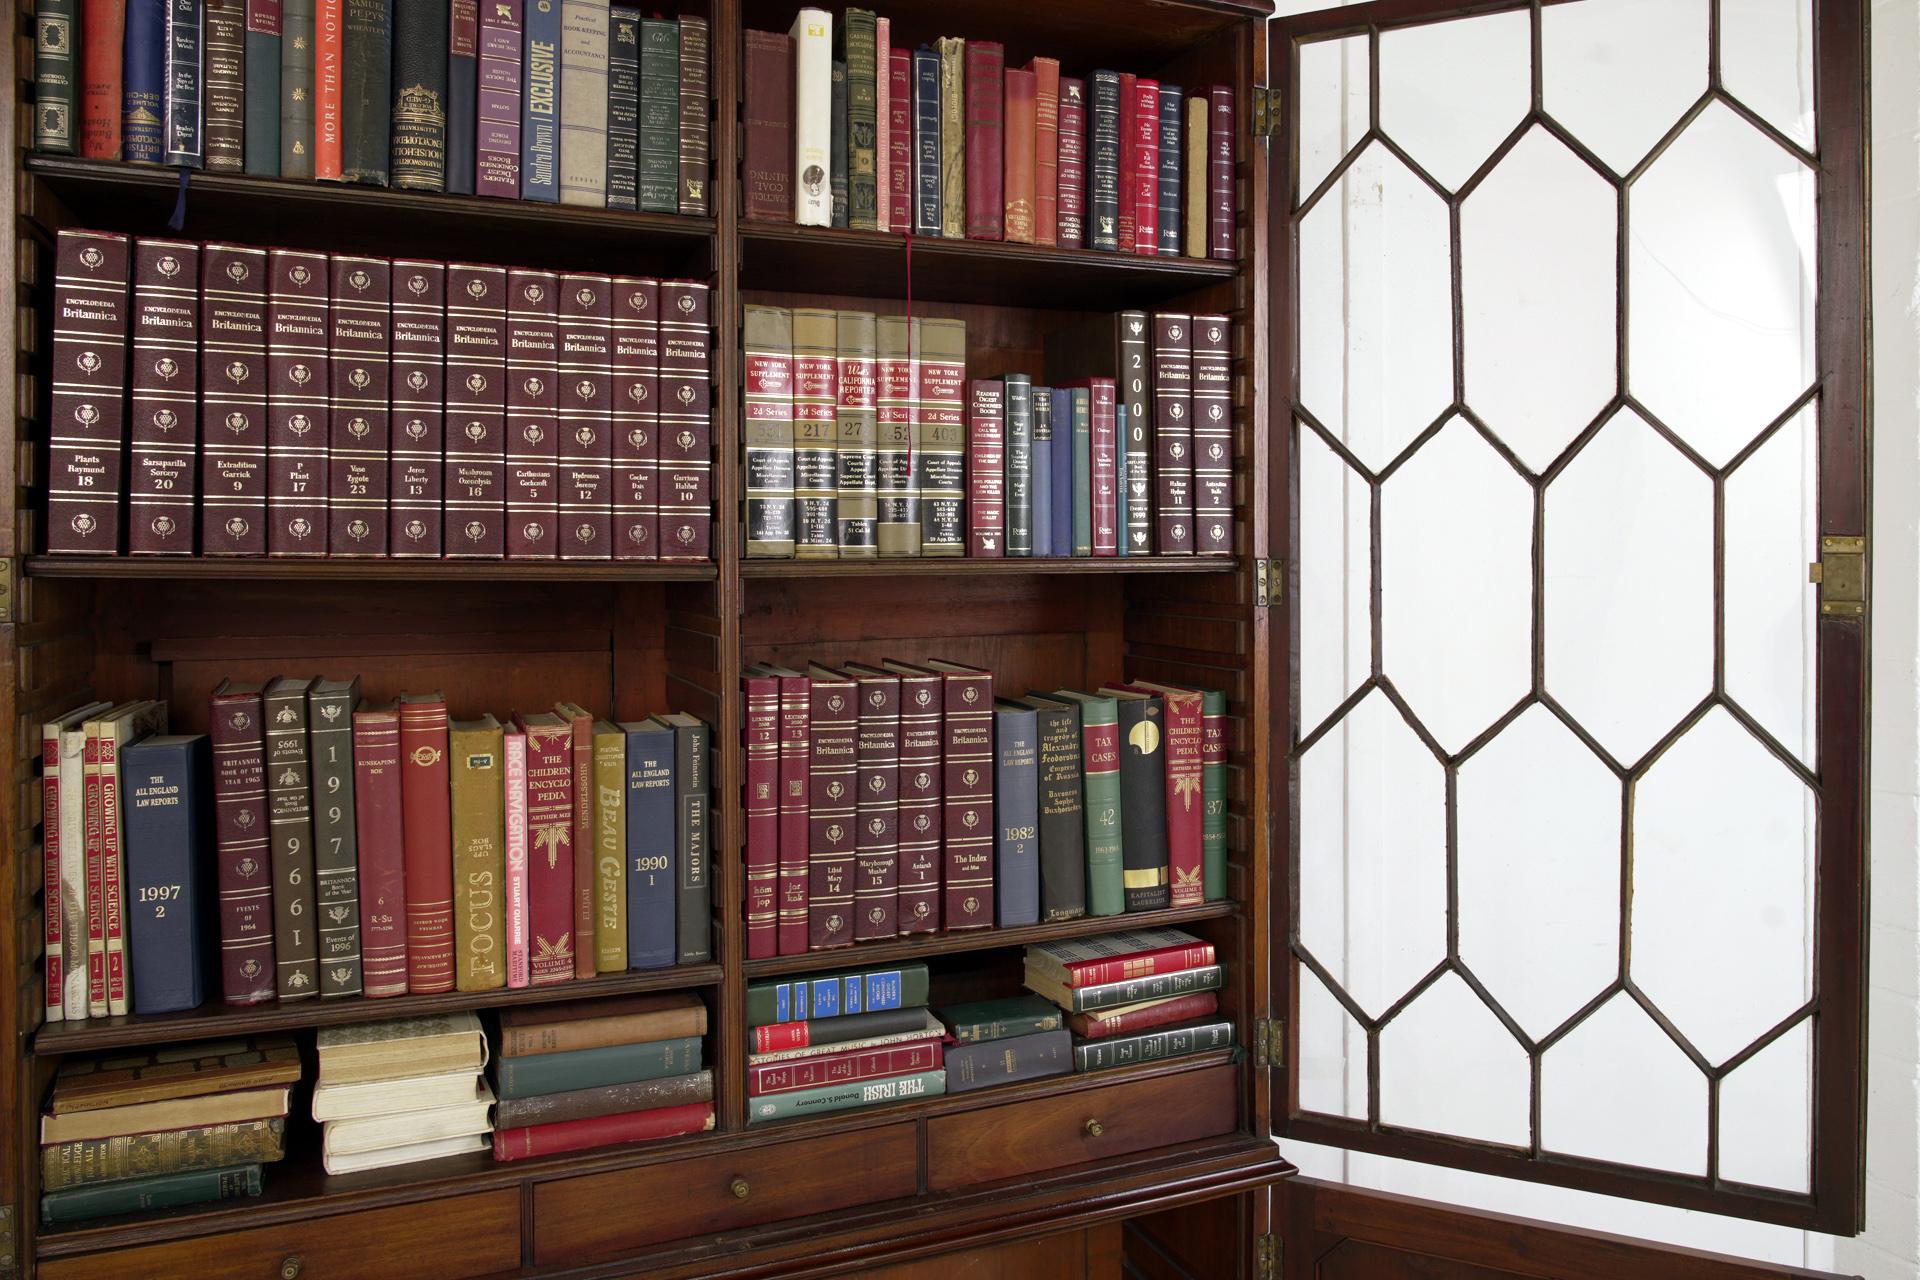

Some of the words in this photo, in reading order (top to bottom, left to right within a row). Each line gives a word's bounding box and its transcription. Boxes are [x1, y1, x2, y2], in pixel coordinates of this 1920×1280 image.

[563, 49, 606, 60] ACCOUNTANCY
[325, 54, 336, 93] THAN
[529, 40, 555, 114] EXCLUSIVE
[325, 104, 336, 143] MORE
[488, 156, 511, 165] BOOKS
[480, 161, 519, 173] CONDENSED
[530, 153, 553, 185] Sandra
[488, 168, 511, 178] DIGEST
[483, 175, 515, 186] READER'S
[755, 181, 784, 192] COAL
[63, 307, 118, 321] Britannica
[141, 315, 193, 328] Britannica
[212, 319, 262, 332] Britannica
[275, 323, 323, 336] Britannica
[335, 327, 383, 340] Britannica
[395, 331, 440, 343] Britannica
[454, 334, 499, 346] Britannica
[511, 338, 555, 350] Britannica
[617, 345, 658, 356] Britannica
[754, 360, 769, 368] NEW
[771, 361, 787, 369] YORK
[816, 363, 832, 371] YORK
[750, 370, 790, 379] SUPPLEMENT
[795, 373, 835, 381] SUPPLEMENT
[944, 369, 959, 377] YORK
[1160, 371, 1191, 380] Britannica
[838, 377, 876, 385] CALIFORNIA
[839, 386, 876, 394] REPORTER
[976, 391, 999, 399] READER'S
[973, 402, 1002, 410] CONDENSED
[753, 408, 762, 416] 2d
[764, 408, 788, 416] Series
[799, 408, 808, 416] 2d
[810, 408, 833, 416] Series
[927, 413, 937, 421] 2d
[939, 413, 960, 421] Series
[844, 423, 862, 436] 27
[75, 455, 100, 463] Plants
[143, 458, 187, 468] Sarsaparilla
[68, 464, 105, 474] Raymund
[217, 460, 257, 470] Extradition
[350, 464, 366, 473] Vase
[150, 468, 179, 478] Sorcery
[222, 470, 252, 479] Garrick
[407, 466, 426, 475] Jerez
[78, 476, 94, 486] 18
[290, 472, 309, 480] Plant
[347, 474, 369, 486] Zygote
[405, 475, 429, 484] Liberty
[155, 479, 174, 489] 20
[233, 481, 243, 491] 9
[292, 482, 306, 492] 17
[350, 484, 366, 494] 23
[409, 486, 423, 495] 13
[469, 487, 483, 497] 16
[530, 489, 538, 498] 5
[579, 490, 592, 500] 12
[634, 492, 643, 501] 6
[680, 492, 698, 501] 10
[1174, 496, 1183, 505] 11
[1214, 496, 1219, 505] 2
[1180, 717, 1196, 725] THE
[1206, 729, 1222, 738] TAX
[278, 739, 297, 750] 1995
[904, 737, 939, 747] Britannica
[1095, 737, 1112, 747] TAX
[1170, 736, 1201, 745] ENCYCLO
[816, 745, 854, 755] Britannica
[1176, 747, 1198, 755] PEDIA
[222, 757, 260, 767] BRITANNICA
[508, 741, 521, 780] RACE
[542, 756, 562, 764] THE
[1091, 752, 1116, 763] CASES
[644, 760, 657, 768] THE
[632, 770, 643, 778] ALL
[644, 769, 670, 778] ENGLAND
[150, 776, 164, 784] THE
[529, 780, 571, 789] ENCYCLO
[632, 780, 644, 788] LAW
[645, 779, 670, 788] REPORTS
[135, 787, 147, 795] ALL
[148, 786, 178, 795] ENGLAND
[537, 791, 566, 801] PEDIA
[136, 798, 149, 806] LAW
[150, 797, 178, 806] REPORTS
[87, 784, 99, 838] GROWING
[103, 783, 115, 836] GROWING
[1207, 800, 1223, 815] 37
[598, 785, 621, 850] BEAU
[691, 800, 701, 827] THE
[1099, 809, 1115, 826] 42
[508, 780, 522, 872] NAVIGATION
[1005, 827, 1034, 841] 1982
[90, 840, 99, 855] UP
[105, 839, 115, 852] UP
[1016, 843, 1024, 854] 2
[690, 832, 701, 883] MAJORS
[953, 855, 968, 865] The
[969, 854, 987, 864] Index
[105, 855, 118, 881] WITH
[634, 856, 668, 872] 1990
[89, 857, 101, 884] WITH
[319, 876, 356, 886] BRITANNICA
[872, 876, 883, 886] 15
[139, 886, 181, 902] 1997
[512, 876, 521, 907] STUART
[599, 857, 621, 930] GESTE
[829, 884, 841, 894] 14
[107, 883, 119, 930] SCIENCE
[378, 897, 384, 906] 6
[90, 885, 102, 931] SCIENCE
[155, 906, 165, 918] 2
[371, 914, 393, 924] R-Su
[470, 870, 495, 977] FOCUS
[512, 908, 522, 945] QUARRIE
[326, 935, 347, 945] Events
[348, 933, 355, 941] of
[330, 941, 351, 952] 1996
[112, 956, 119, 971] 2
[532, 960, 564, 969] VOLUME
[840, 1041, 866, 1053] MUSIC
[880, 1036, 903, 1047] JOHN
[899, 1078, 925, 1094] THE
[863, 1081, 897, 1102] IRISH
[838, 1092, 860, 1102] Donald
[795, 1096, 828, 1109] Connery
